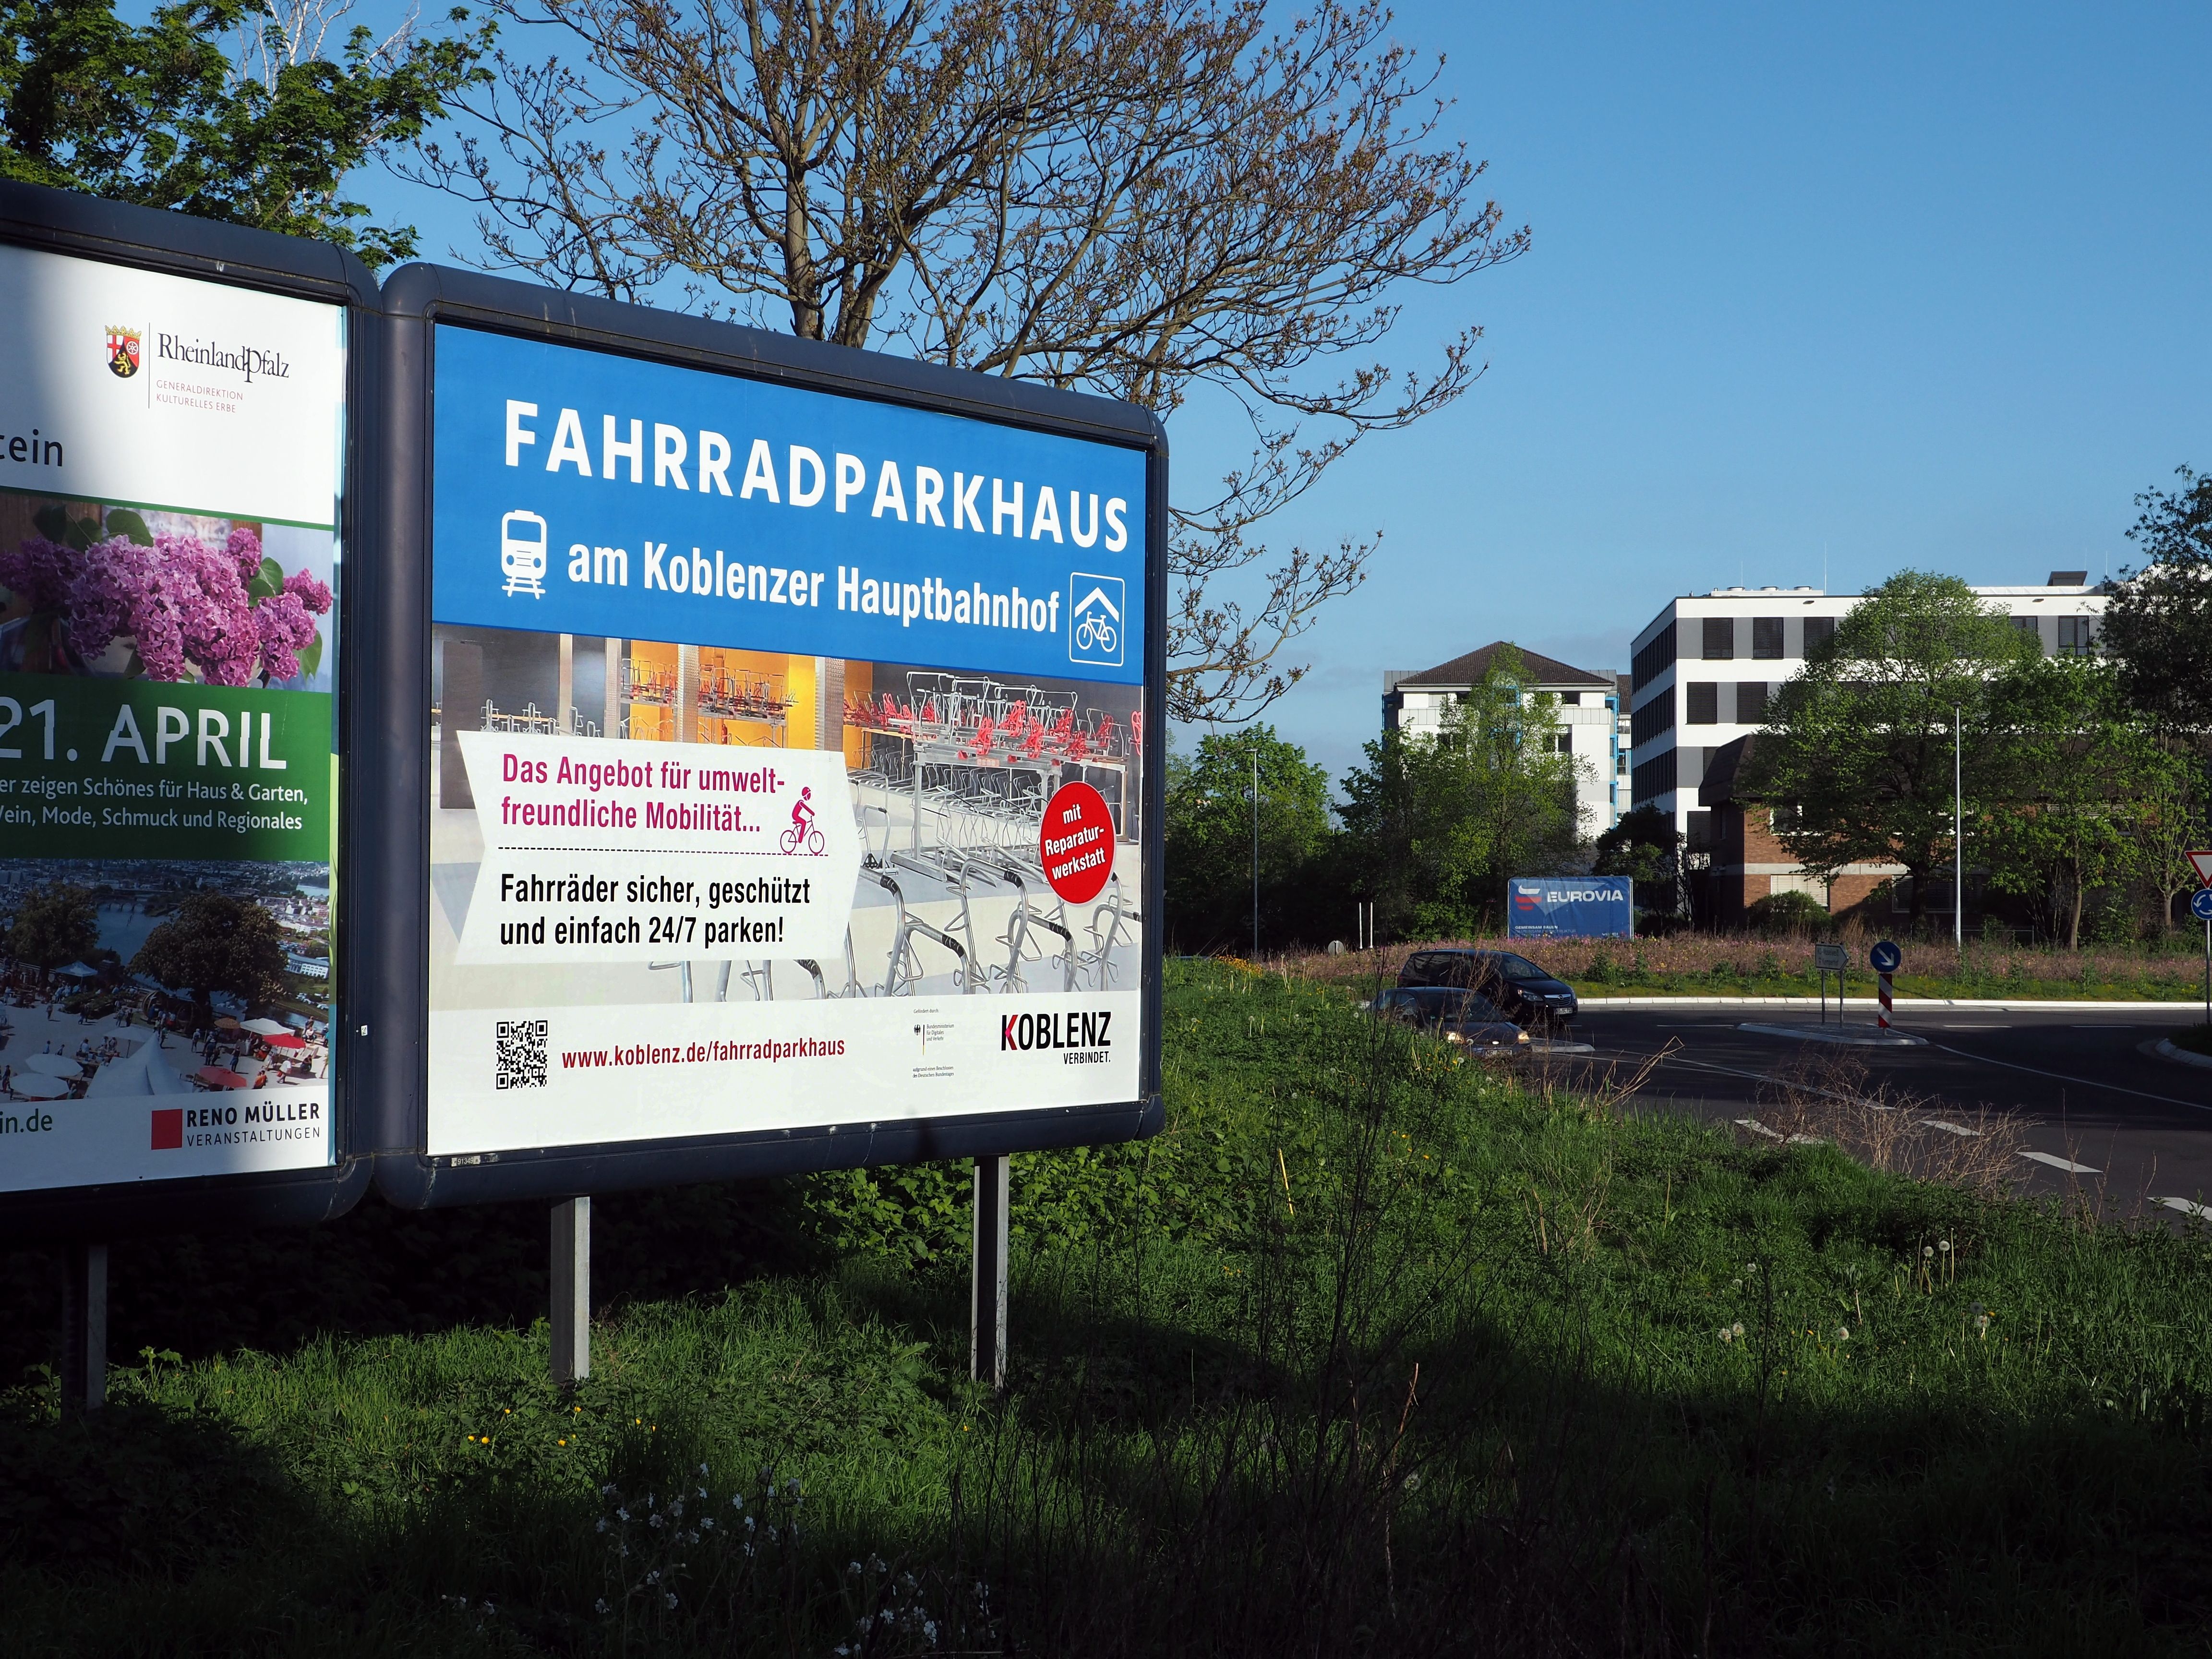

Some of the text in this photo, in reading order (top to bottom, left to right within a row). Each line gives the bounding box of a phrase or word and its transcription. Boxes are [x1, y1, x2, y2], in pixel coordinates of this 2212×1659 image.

[156, 380, 243, 400] GENERALDIREKTION
[156, 394, 236, 413] KULTURELLES ERBE
[505, 399, 1127, 553] FAHRRADPARKHAUS
[568, 541, 1059, 633] am Koblenzer Hauptbahnhof
[0, 696, 287, 769] 21. APRIL
[503, 754, 785, 793] Das Angebot für umwelt-
[21, 776, 77, 799] zeigen
[83, 778, 154, 797] Schönes
[159, 780, 183, 798] für
[188, 781, 227, 799] Haus
[231, 783, 244, 800] &
[249, 783, 308, 805] Garten,
[42, 805, 96, 828] Mode,
[102, 807, 178, 827] Schmuck
[183, 809, 212, 827] und
[217, 811, 302, 833] Regionales
[501, 796, 760, 832] freundliche Mobilität...
[1063, 804, 1082, 824] mit
[1045, 826, 1105, 856] Reparatur-
[1052, 847, 1106, 880] werkstatt
[501, 873, 810, 909] Fahrräder sicher, geschützt
[1547, 890, 1623, 902] EUROVIA
[501, 915, 783, 949] und einfach 24/7 parken!
[1001, 1011, 1111, 1051] KOBLENZ
[562, 1037, 845, 1068] www.koblenz.de/fahrradparkhaus
[1063, 1051, 1111, 1065] VERBINDET.
[187, 1100, 320, 1128] RENO MÜLLER
[187, 1127, 320, 1147] VERANSTALTUNGEN
[457, 1156, 474, 1165] 91349
